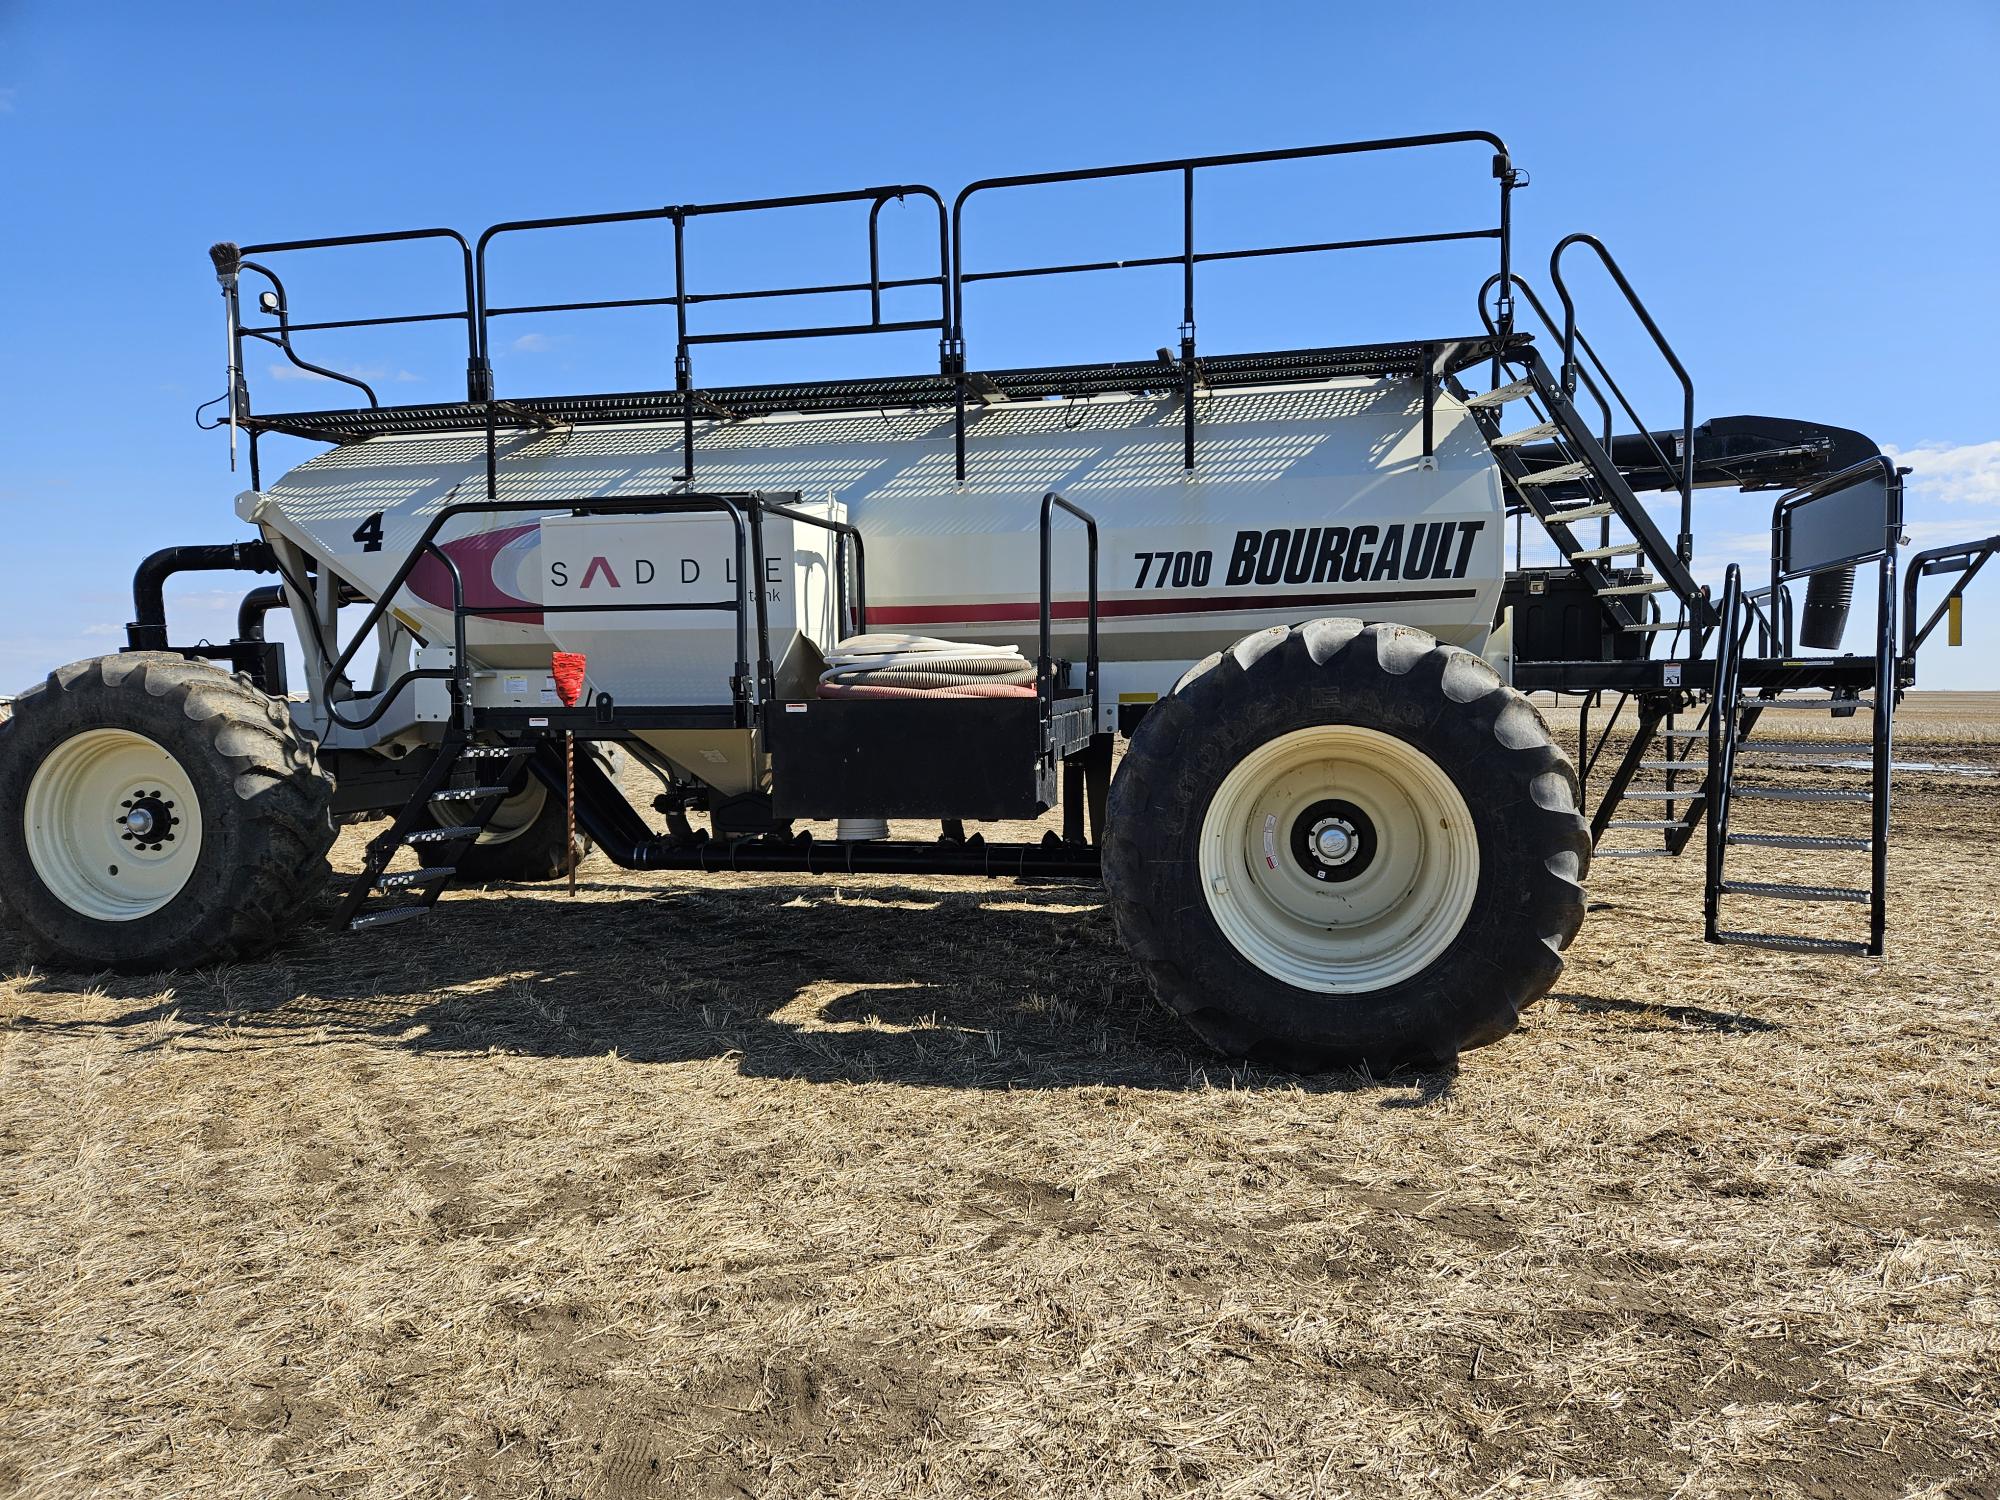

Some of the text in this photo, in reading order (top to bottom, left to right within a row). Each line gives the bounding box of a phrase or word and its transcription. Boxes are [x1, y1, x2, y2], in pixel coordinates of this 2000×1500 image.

[352, 511, 385, 553] 4
[551, 556, 783, 588] SADDLE
[1134, 520, 1486, 589] 7700 BOURGAULT
[748, 588, 781, 602] tnk
